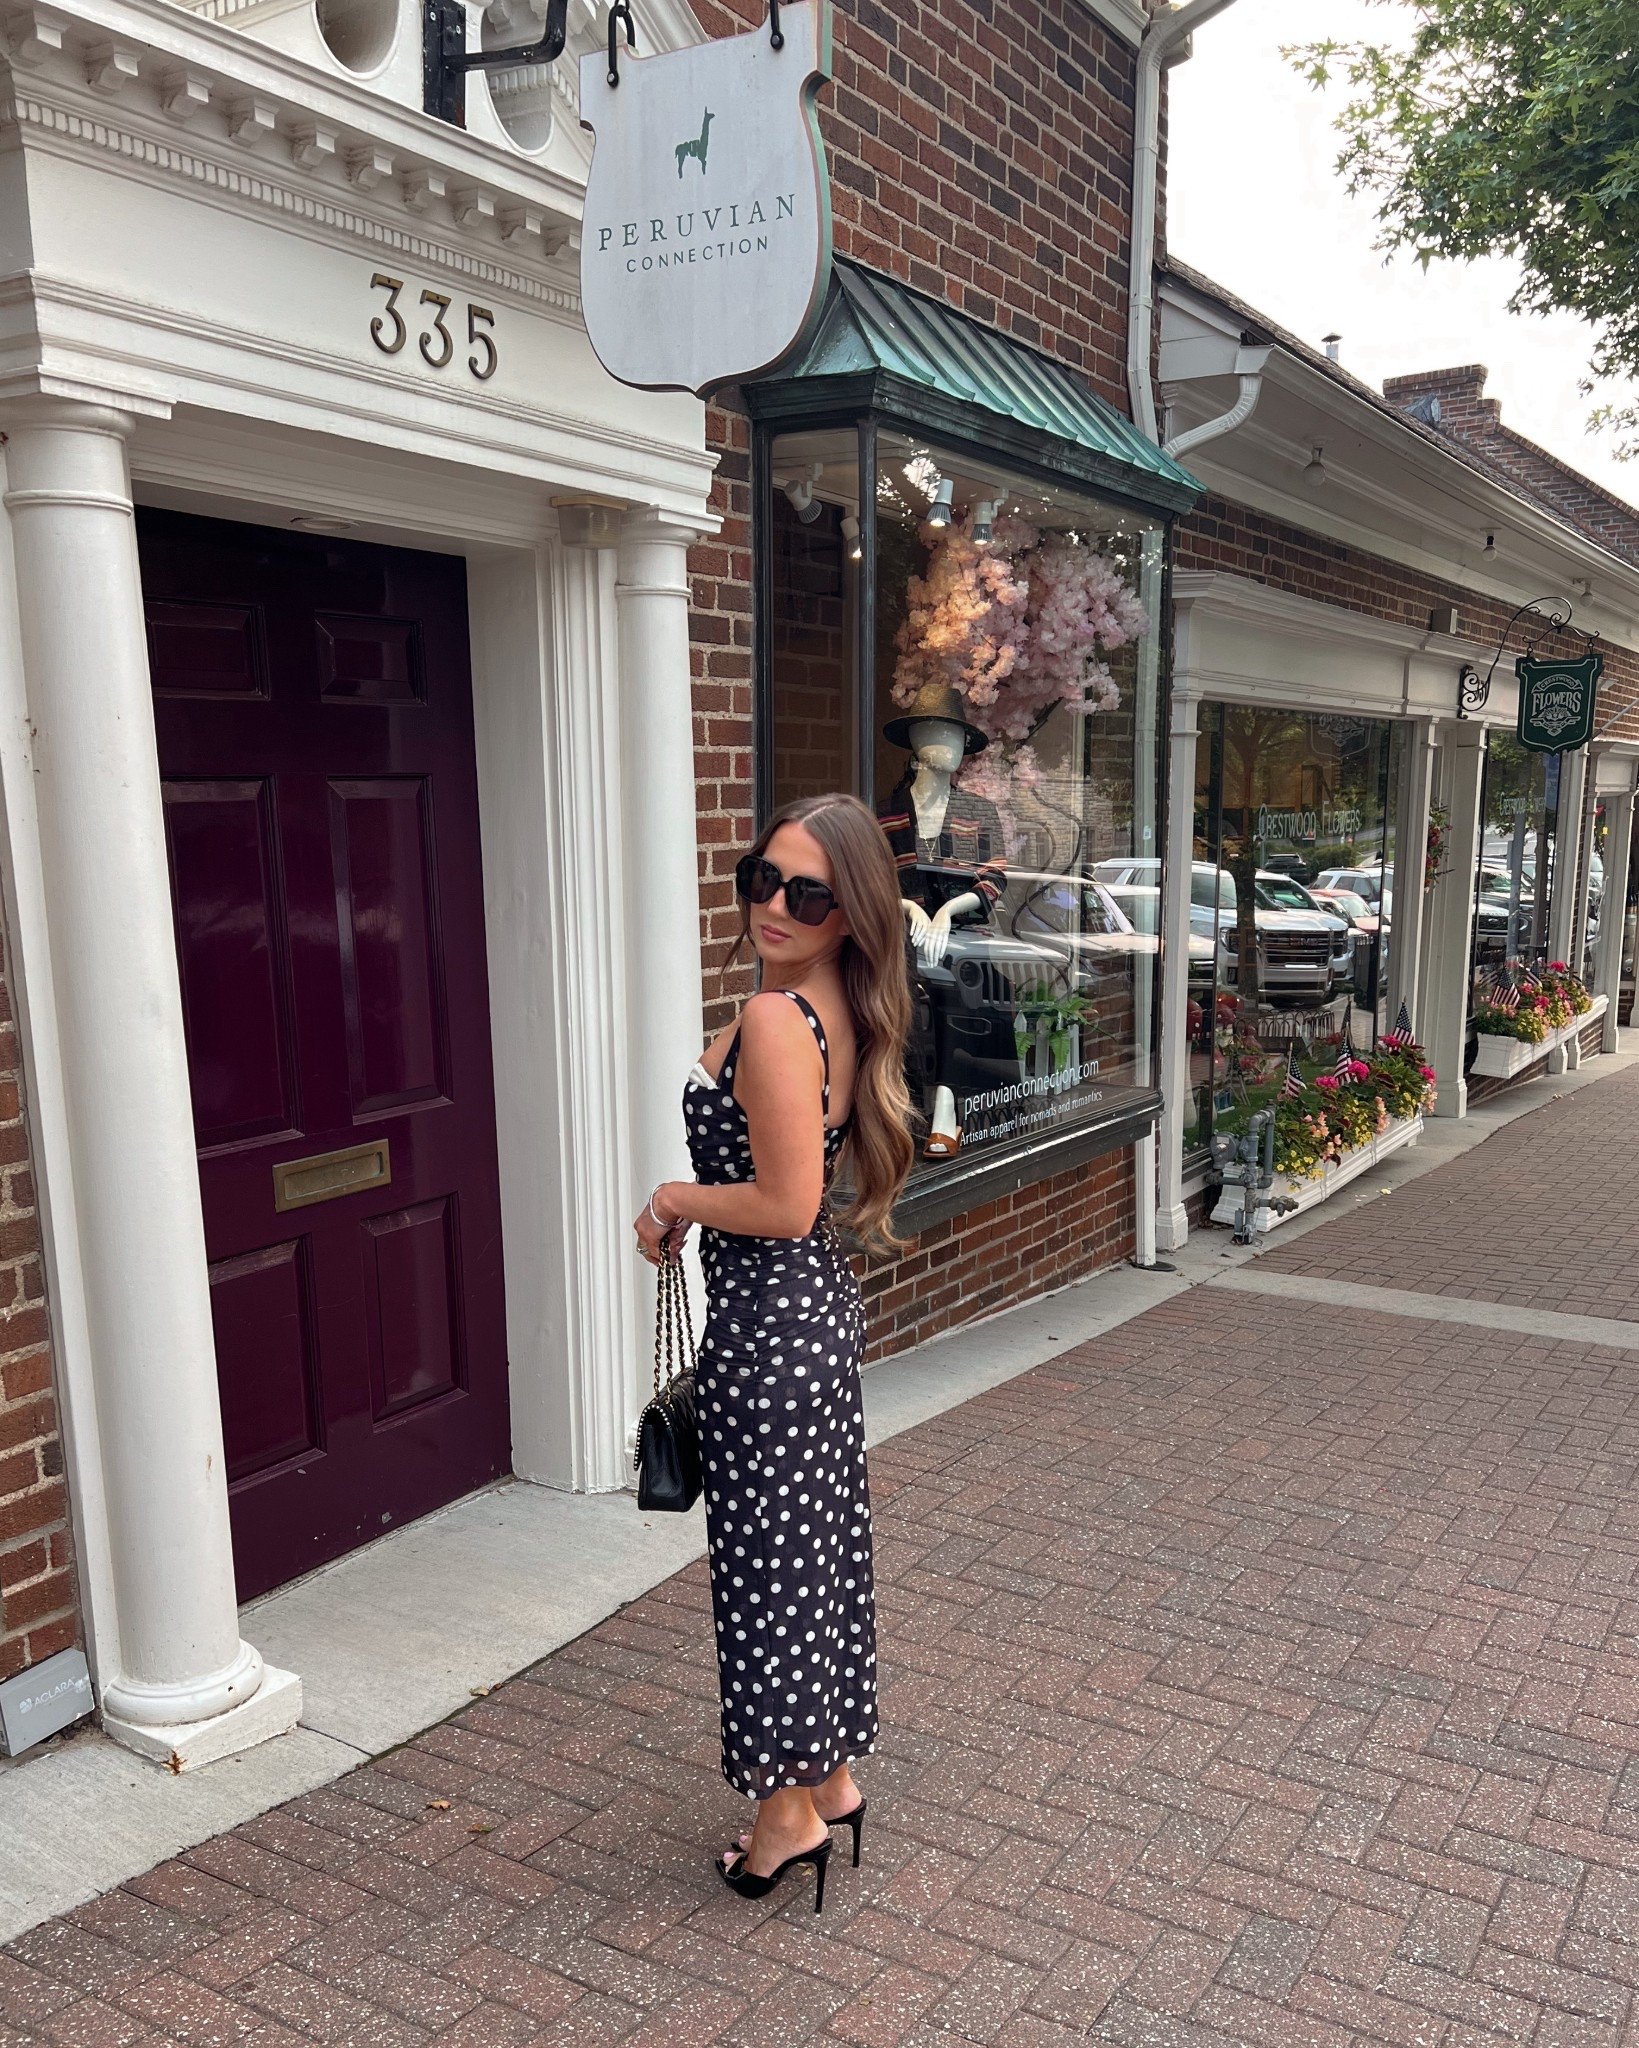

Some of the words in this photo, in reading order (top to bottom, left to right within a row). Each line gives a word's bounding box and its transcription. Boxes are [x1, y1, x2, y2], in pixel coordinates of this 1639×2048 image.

[598, 193, 796, 252] PERUVIAN
[626, 235, 769, 273] CONNECTION
[370, 272, 498, 381] 335
[1531, 691, 1582, 717] FLOWERS
[960, 1128, 989, 1147] Artisan
[990, 1113, 1018, 1139] apparel
[1019, 1112, 1029, 1127] for
[1030, 1102, 1057, 1124] nomads
[1058, 1096, 1071, 1114] and
[1072, 1088, 1103, 1110] romantics
[964, 1060, 1100, 1121] peruvianconnection.com
[34, 1678, 76, 1709] ACLARA
